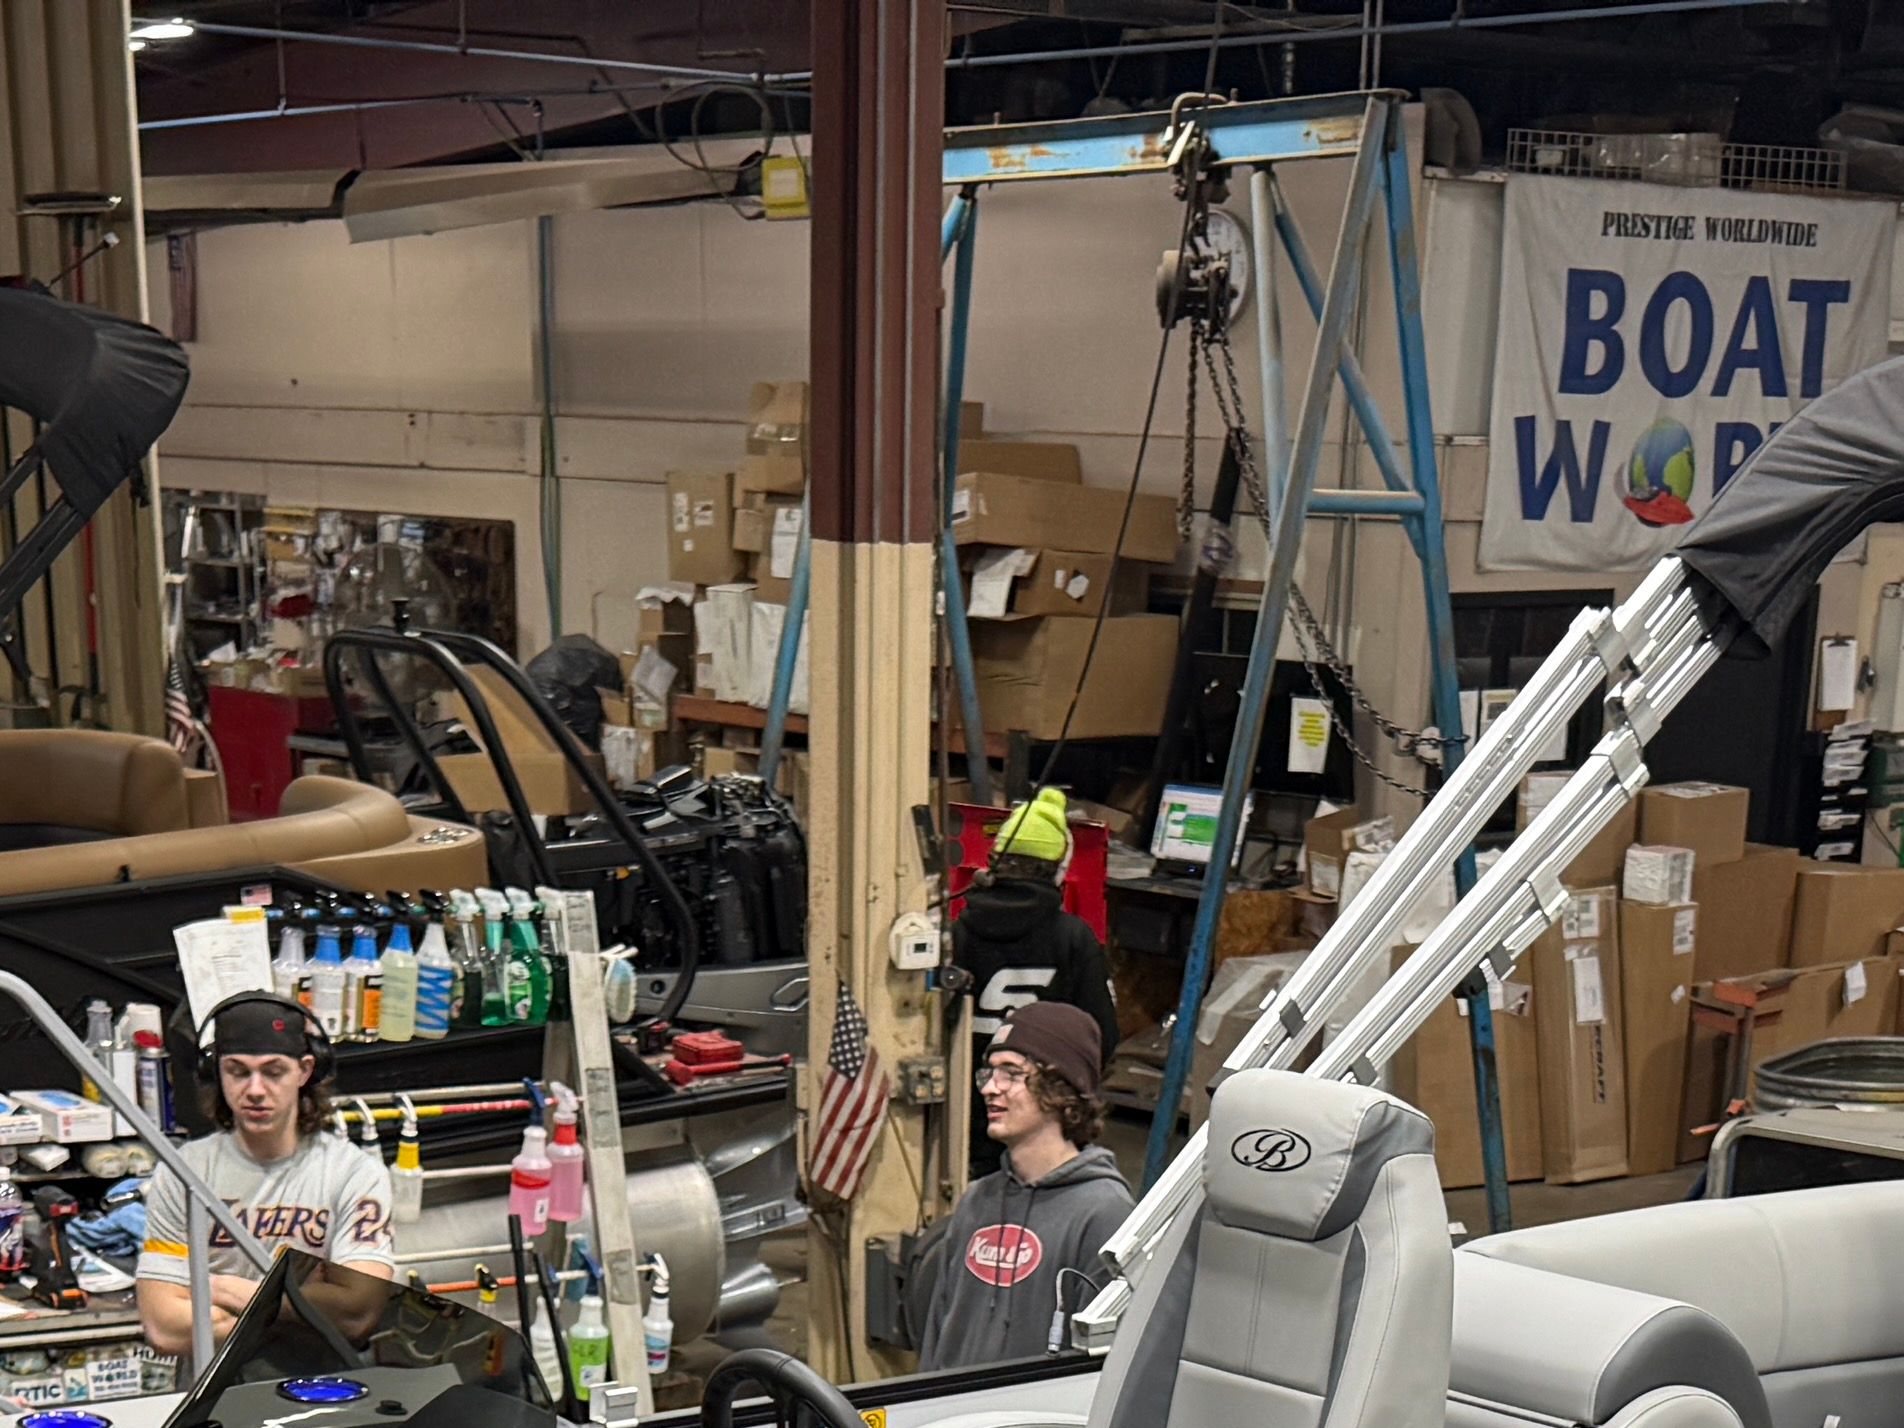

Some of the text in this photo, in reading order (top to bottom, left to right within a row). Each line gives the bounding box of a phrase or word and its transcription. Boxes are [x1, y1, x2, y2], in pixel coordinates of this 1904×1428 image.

[1600, 210, 1819, 248] PRESTIGE WORLDWIDE
[1558, 268, 1851, 399] BOAT
